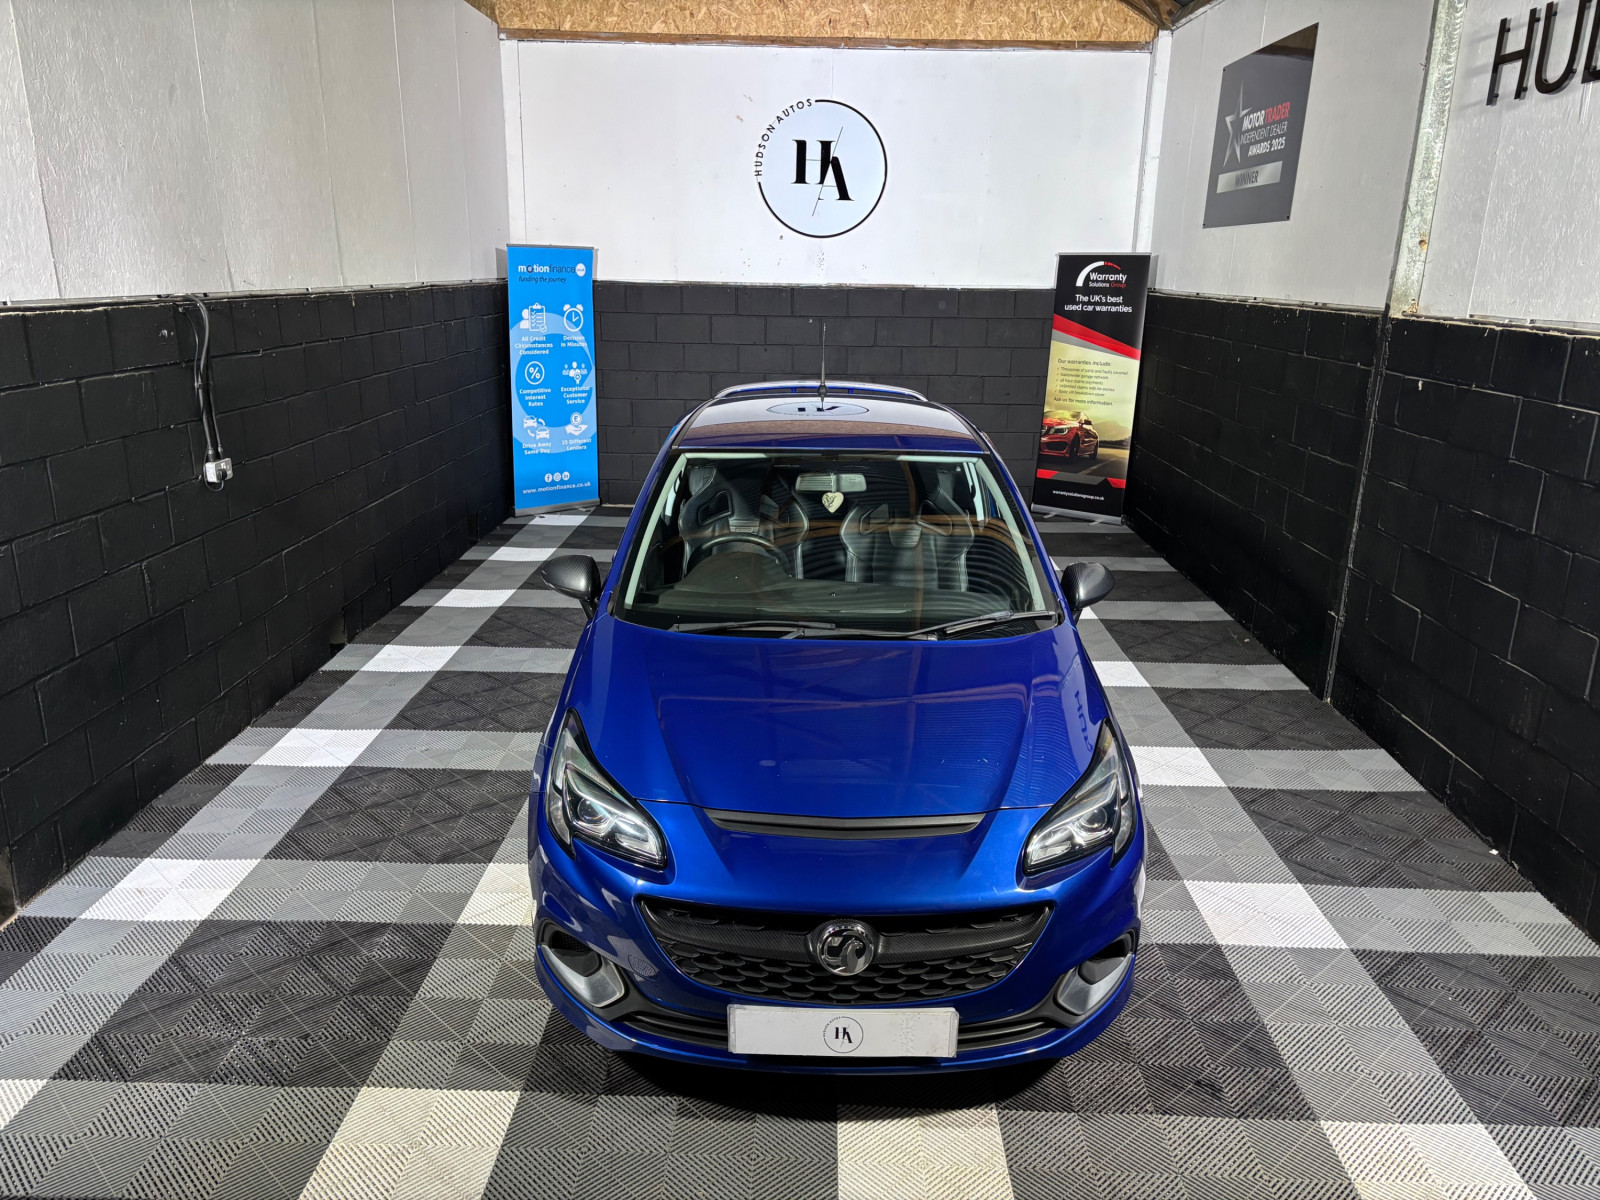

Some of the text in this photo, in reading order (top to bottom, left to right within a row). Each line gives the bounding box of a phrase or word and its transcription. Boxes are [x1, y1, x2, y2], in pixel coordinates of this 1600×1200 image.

[754, 98, 813, 176] HUDSON AUTOS
[1240, 121, 1288, 145] INDEPENDENT DEALER
[1247, 137, 1286, 157] AWARDS 2025
[1234, 170, 1259, 187] WINNER
[519, 275, 539, 284] funding
[548, 276, 567, 284] journey
[1089, 272, 1127, 283] Warranty
[1075, 294, 1123, 303] The UK's best
[1065, 303, 1082, 311] used
[1095, 304, 1133, 313] warranties
[519, 387, 552, 395] Competitive
[522, 481, 591, 494] www.motionfinance.co.uk
[1052, 489, 1105, 501] warrantysolutionsgroup.co.uk
